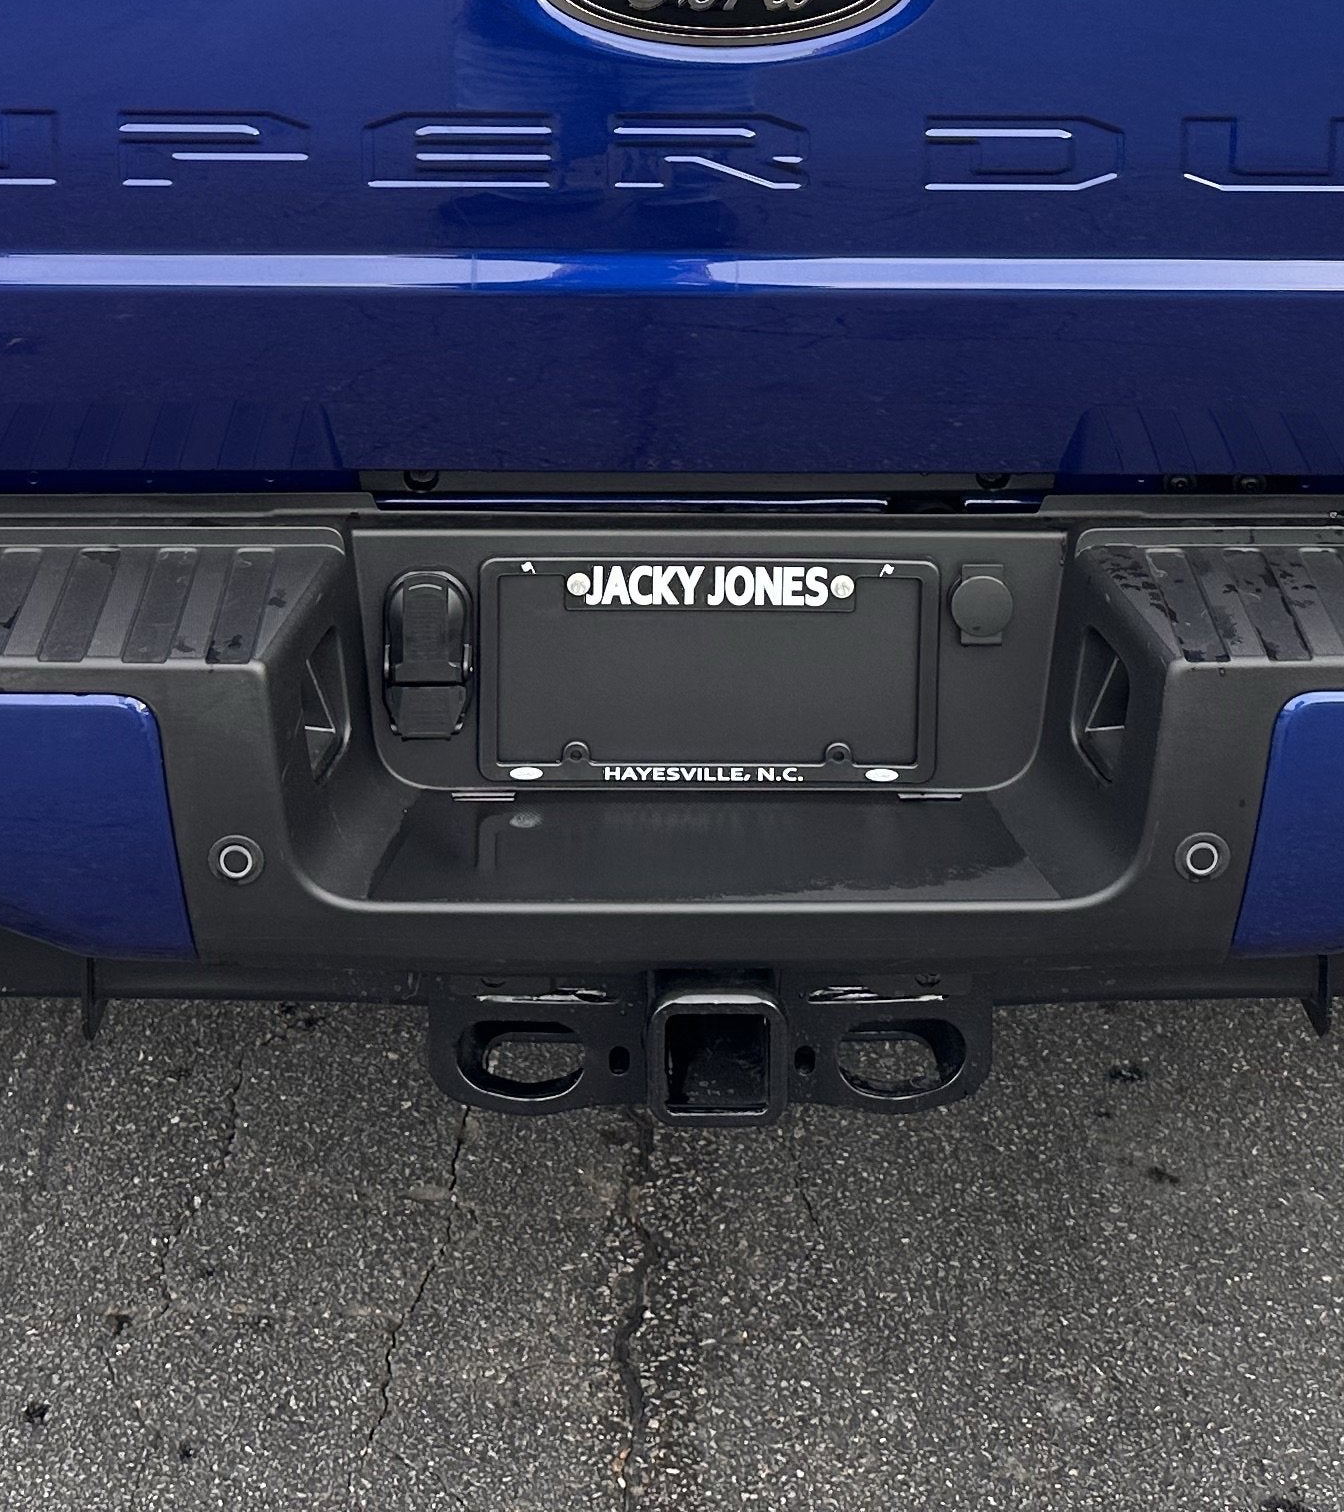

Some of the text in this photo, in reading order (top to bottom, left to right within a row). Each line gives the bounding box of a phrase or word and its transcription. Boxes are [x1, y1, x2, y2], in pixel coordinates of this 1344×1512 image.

[585, 565, 829, 607] JACKY JONES
[604, 766, 804, 782] HAYESVILLE, N.C.
